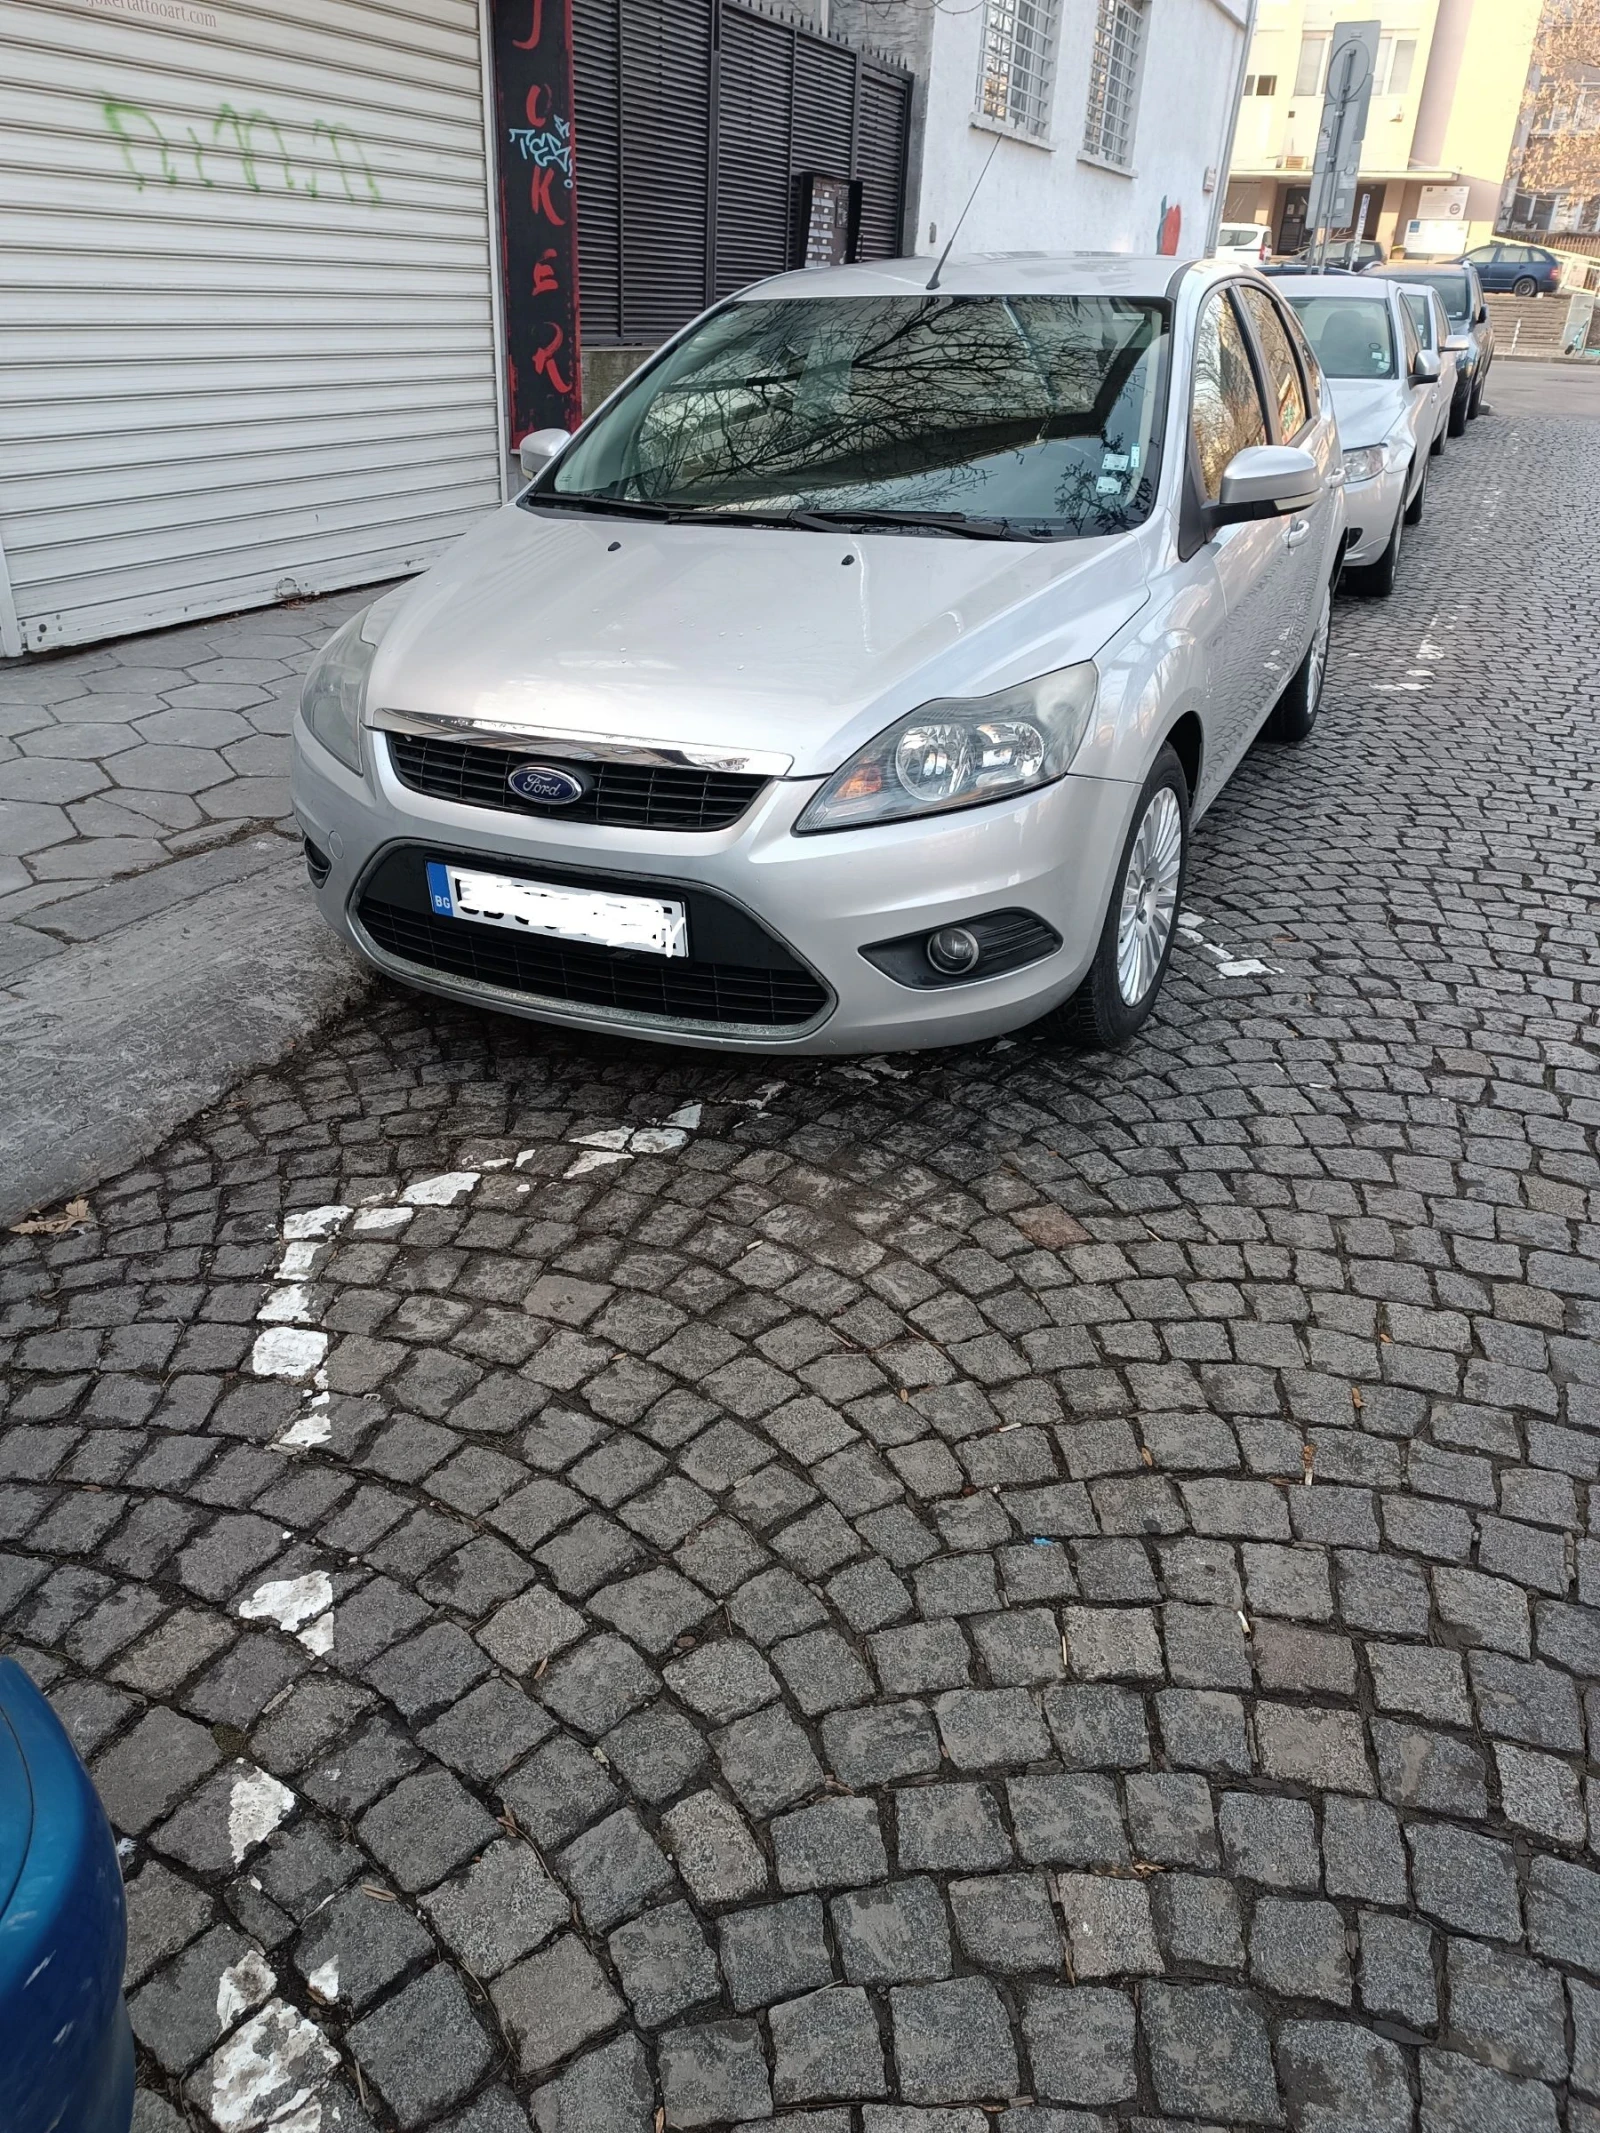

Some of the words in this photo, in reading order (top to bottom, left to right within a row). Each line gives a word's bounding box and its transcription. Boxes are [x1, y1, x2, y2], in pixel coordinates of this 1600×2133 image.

[87, 0, 217, 28] ertattooart.com
[522, 773, 562, 797] Ford
[434, 894, 451, 909] BG
